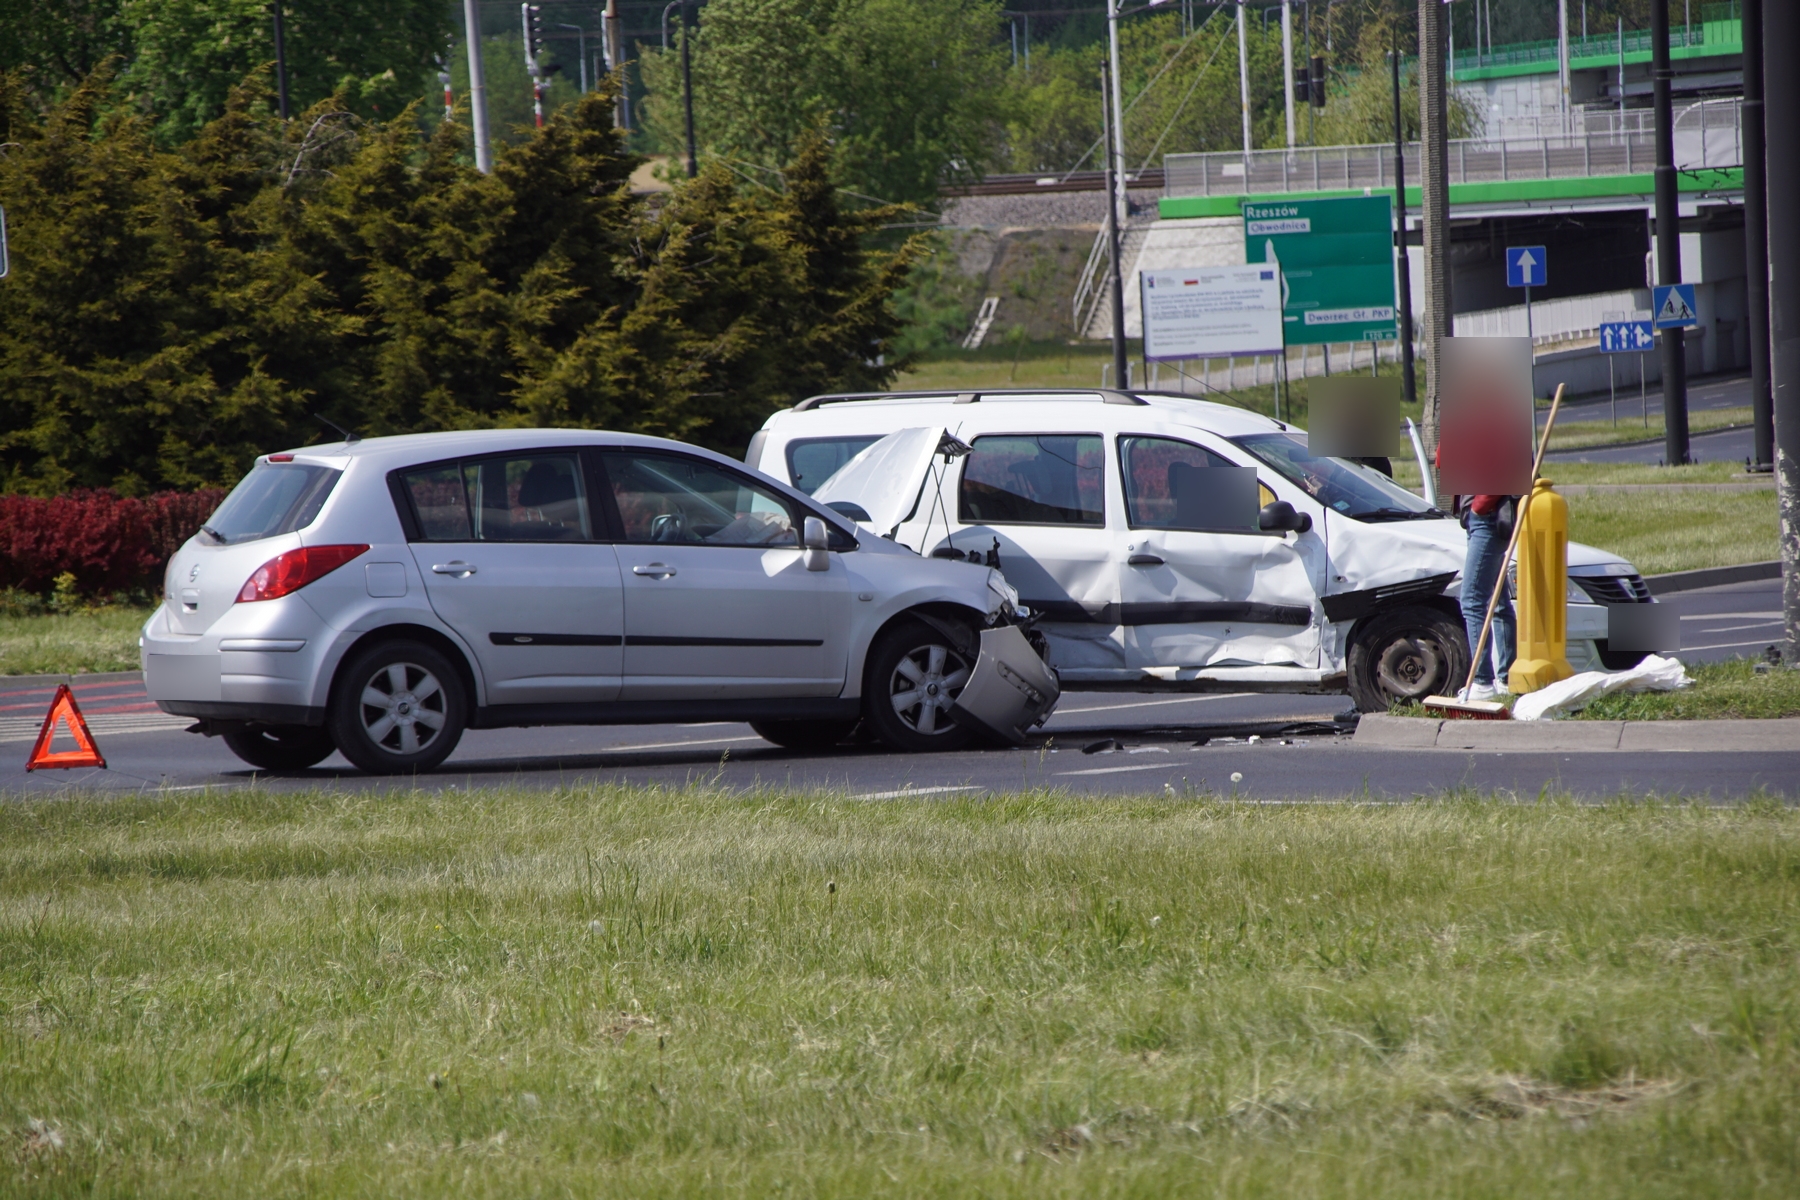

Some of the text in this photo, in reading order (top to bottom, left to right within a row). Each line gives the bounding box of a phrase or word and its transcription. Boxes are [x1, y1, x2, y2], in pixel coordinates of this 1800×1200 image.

[1246, 204, 1298, 218] Rzeszów
[1251, 221, 1306, 232] Obwodnica
[1308, 312, 1349, 322] Dworzec
[1372, 308, 1390, 318] PKP
